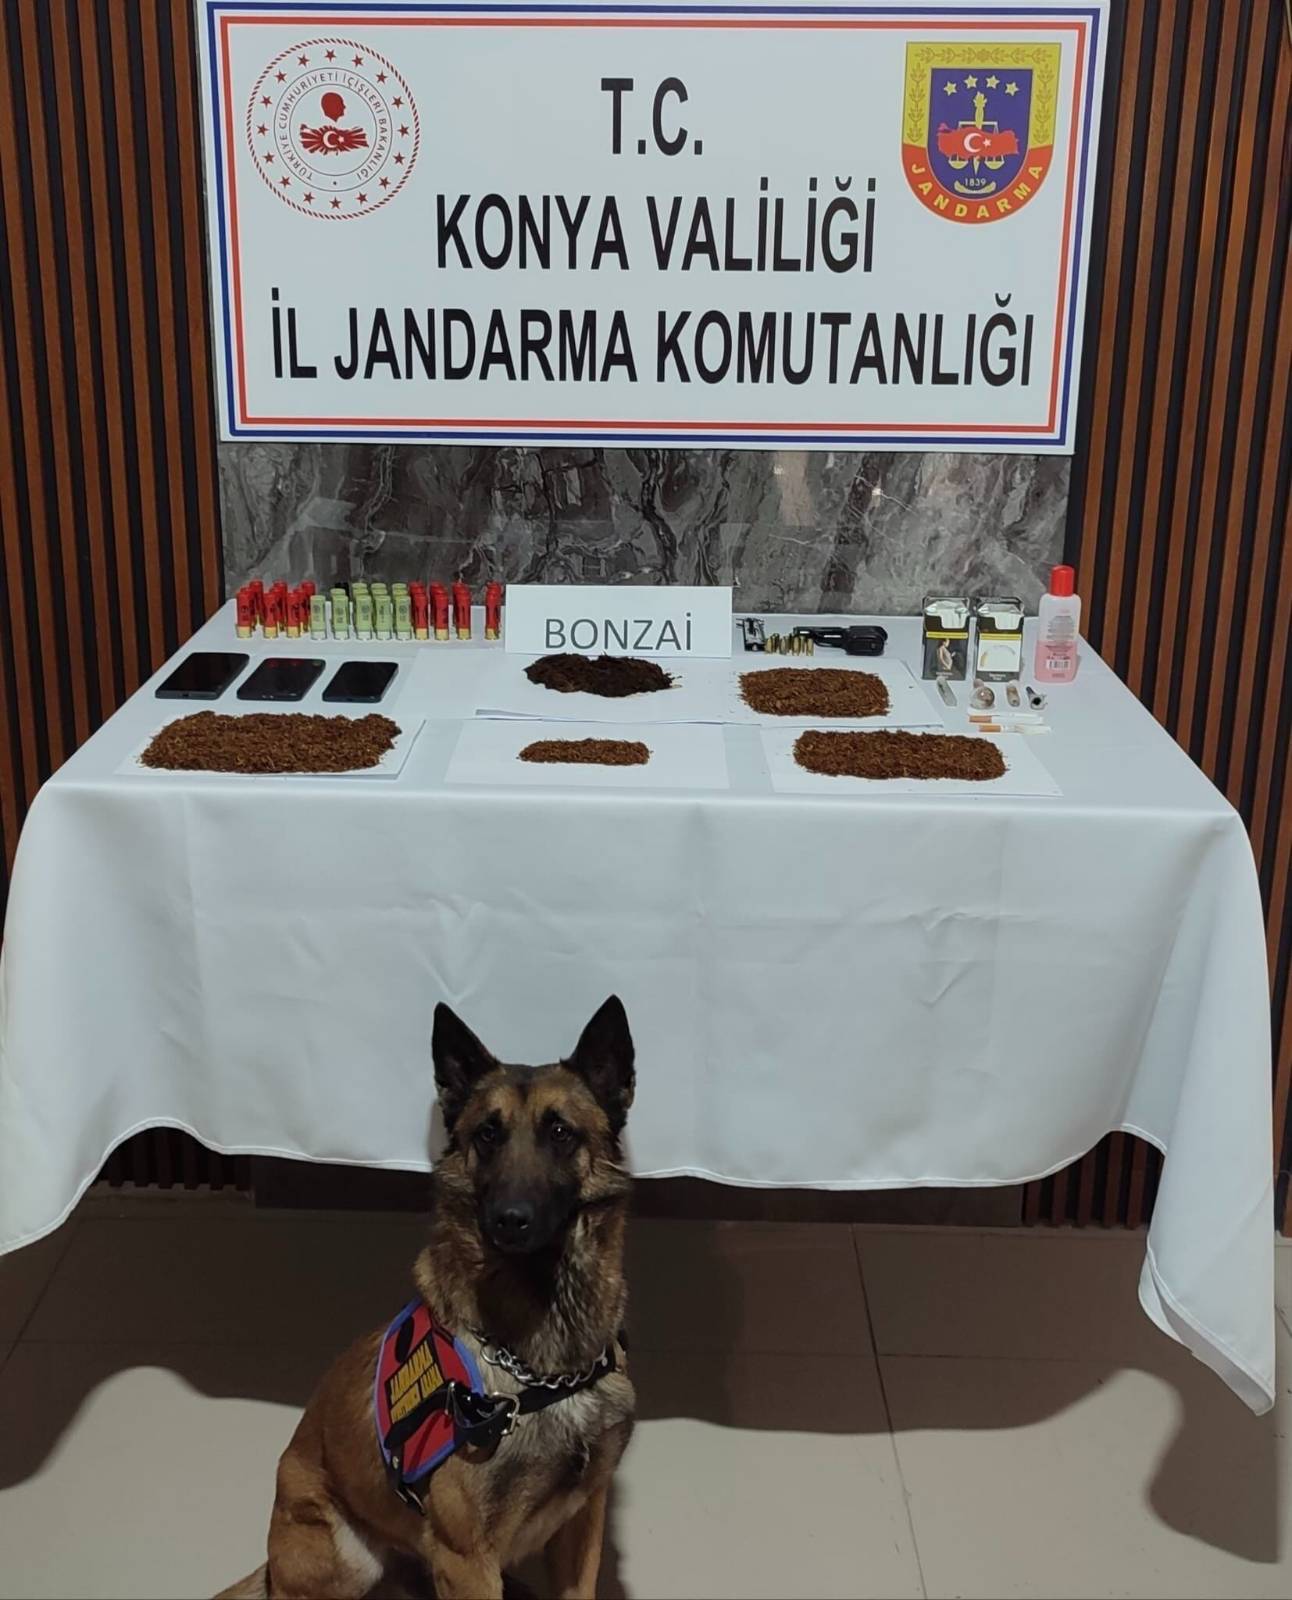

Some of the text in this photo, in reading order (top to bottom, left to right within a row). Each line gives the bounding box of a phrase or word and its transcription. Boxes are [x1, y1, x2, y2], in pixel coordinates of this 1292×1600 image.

[279, 71, 388, 181] TÜRKİYE CUMHURİYETİ İÇİŞLERİ BAKANLIĞI
[601, 77, 703, 156] T.C.
[911, 163, 1043, 218] JANDARMA
[964, 178, 986, 187] 1839
[437, 176, 876, 273] KONYA VALİLİĞİ
[271, 287, 1034, 386] İL JANDARMA KOMUTANLIĞI
[545, 612, 692, 651] BONZAİ
